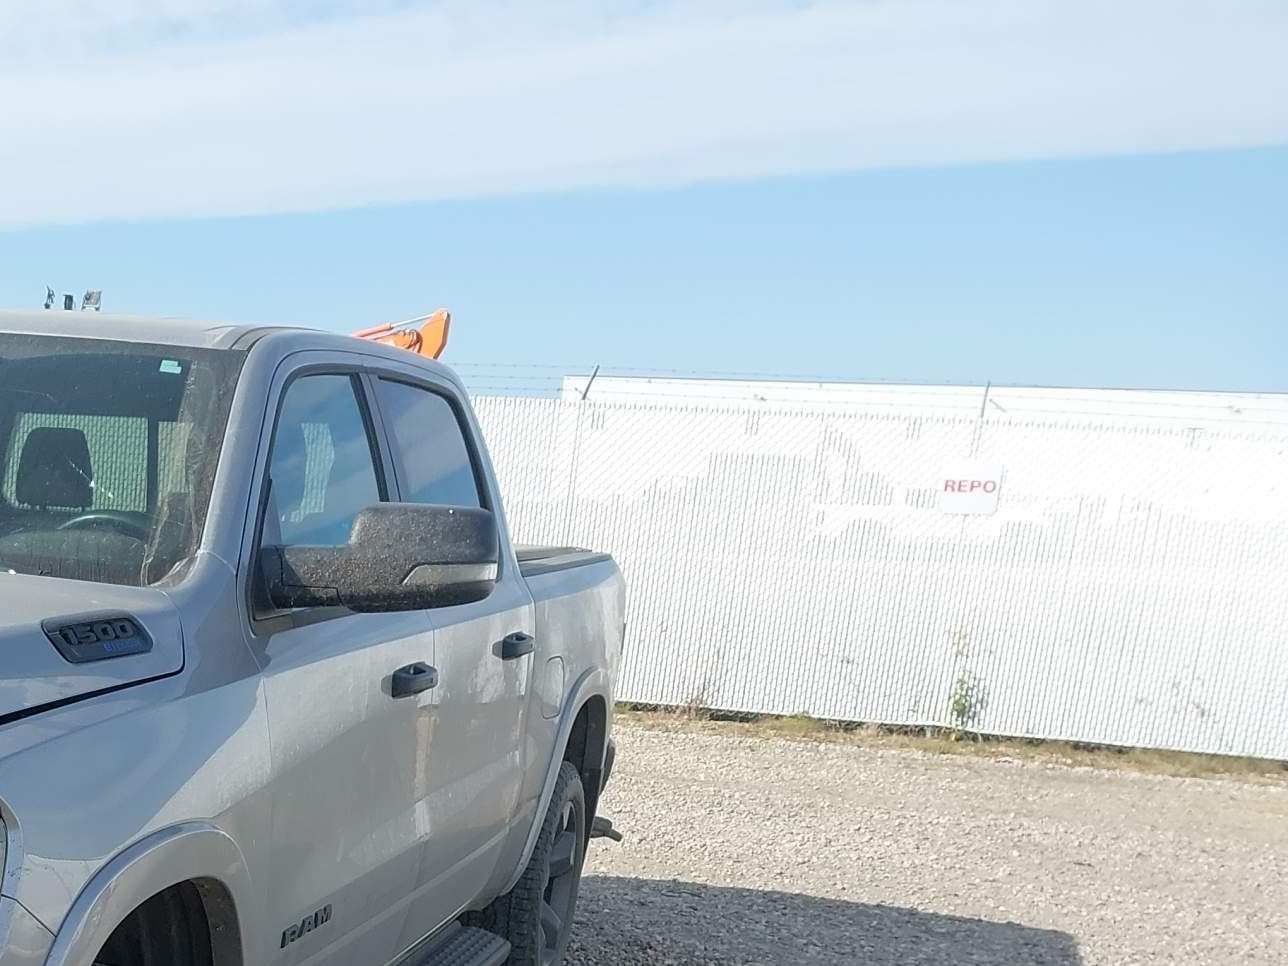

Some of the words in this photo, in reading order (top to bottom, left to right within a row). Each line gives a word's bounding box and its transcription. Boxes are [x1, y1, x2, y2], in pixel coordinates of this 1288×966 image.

[943, 479, 997, 493] REPO
[58, 620, 134, 645] 1500
[279, 903, 333, 949] RAM
